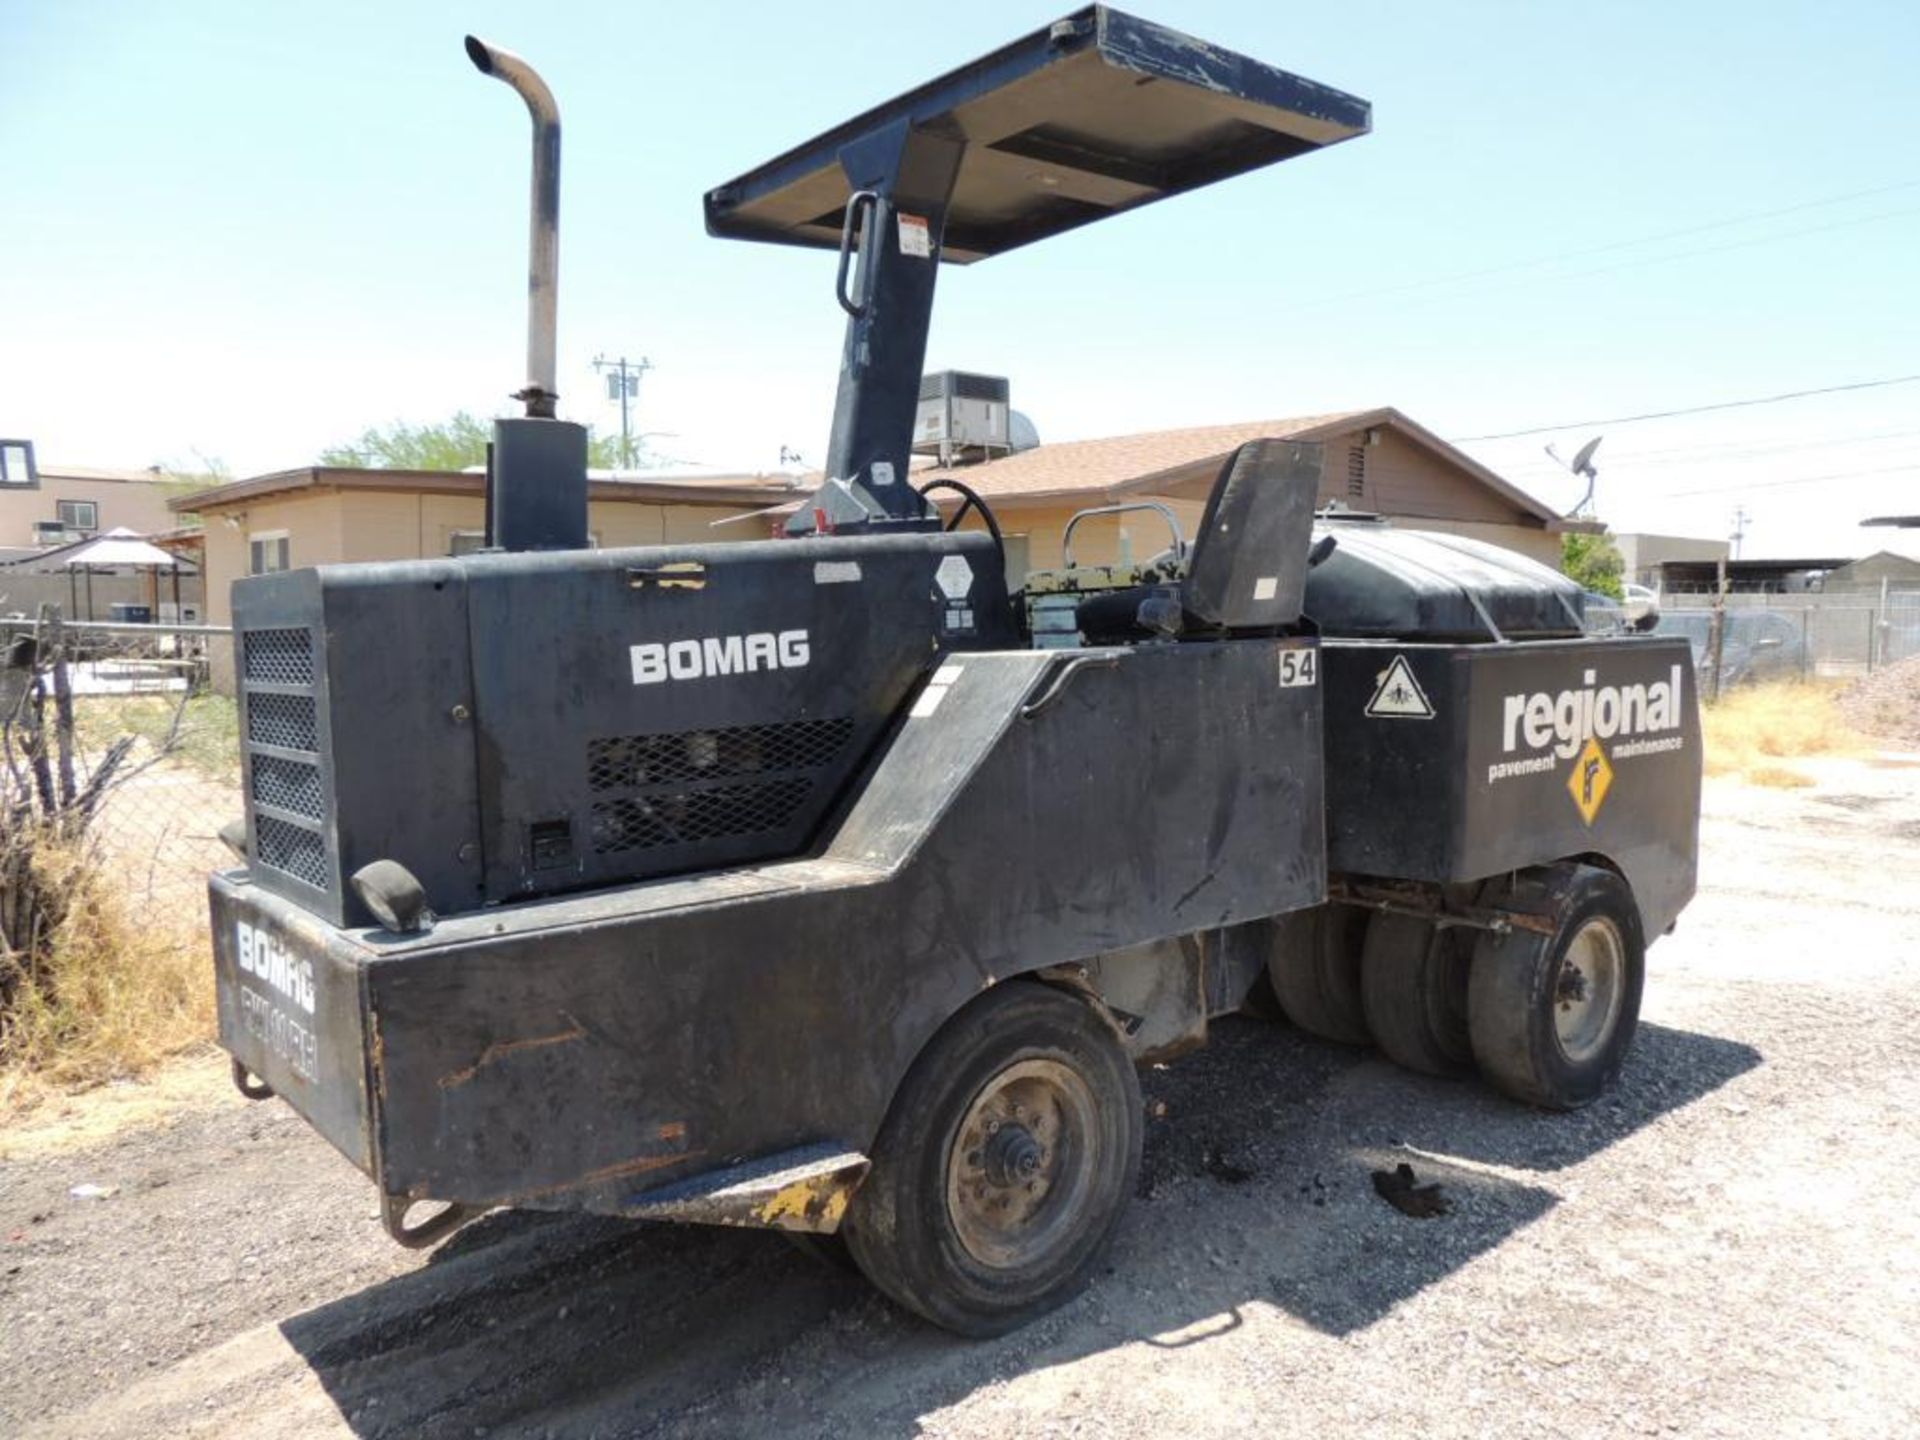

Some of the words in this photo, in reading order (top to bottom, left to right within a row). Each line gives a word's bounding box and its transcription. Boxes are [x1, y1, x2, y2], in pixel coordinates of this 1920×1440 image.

[630, 629, 810, 685] BOMAG
[1283, 651, 1313, 684] 54
[1503, 664, 1682, 759] regional
[1489, 753, 1555, 785] pavement
[1612, 737, 1683, 759] maintenance
[237, 921, 316, 1014] BOMAG
